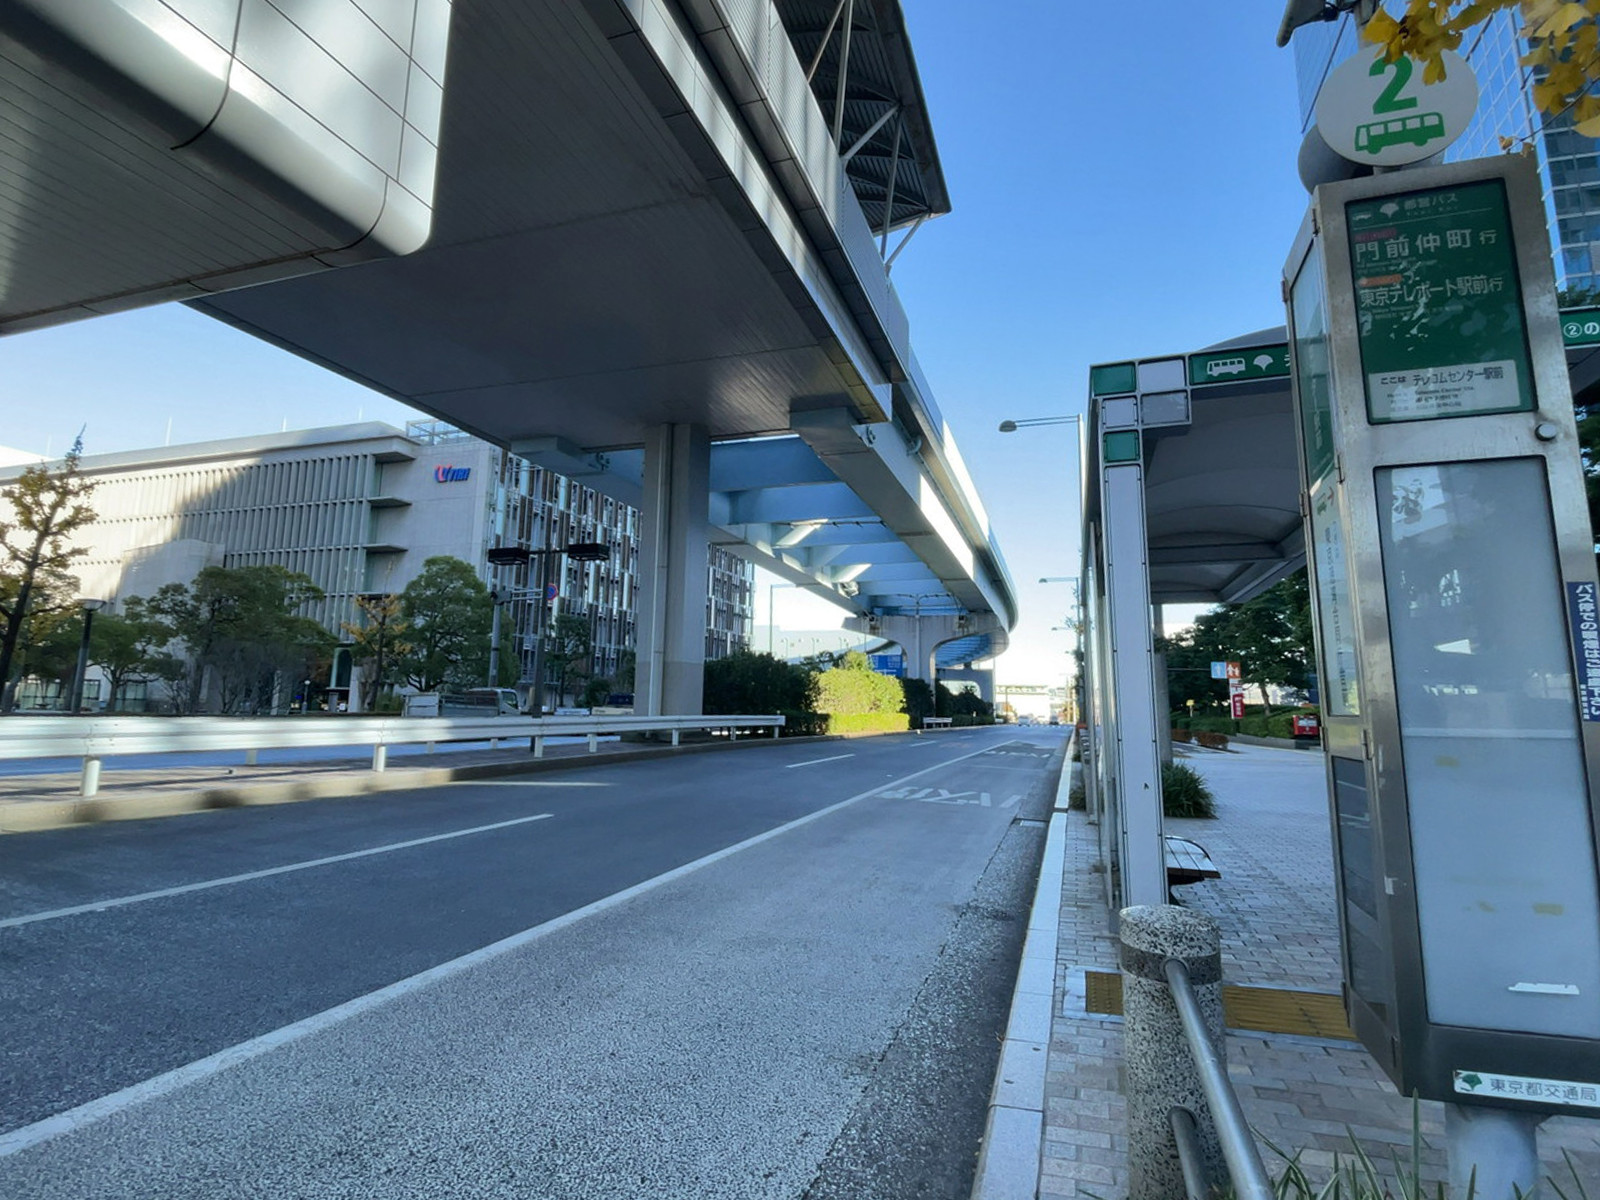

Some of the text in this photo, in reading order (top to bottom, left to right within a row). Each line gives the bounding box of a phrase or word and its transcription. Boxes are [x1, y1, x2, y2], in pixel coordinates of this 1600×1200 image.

[1369, 54, 1418, 115] 2
[1404, 193, 1458, 210] 都営バス
[1380, 376, 1406, 386] ここは
[1490, 1078, 1597, 1102] 東京都交通局
